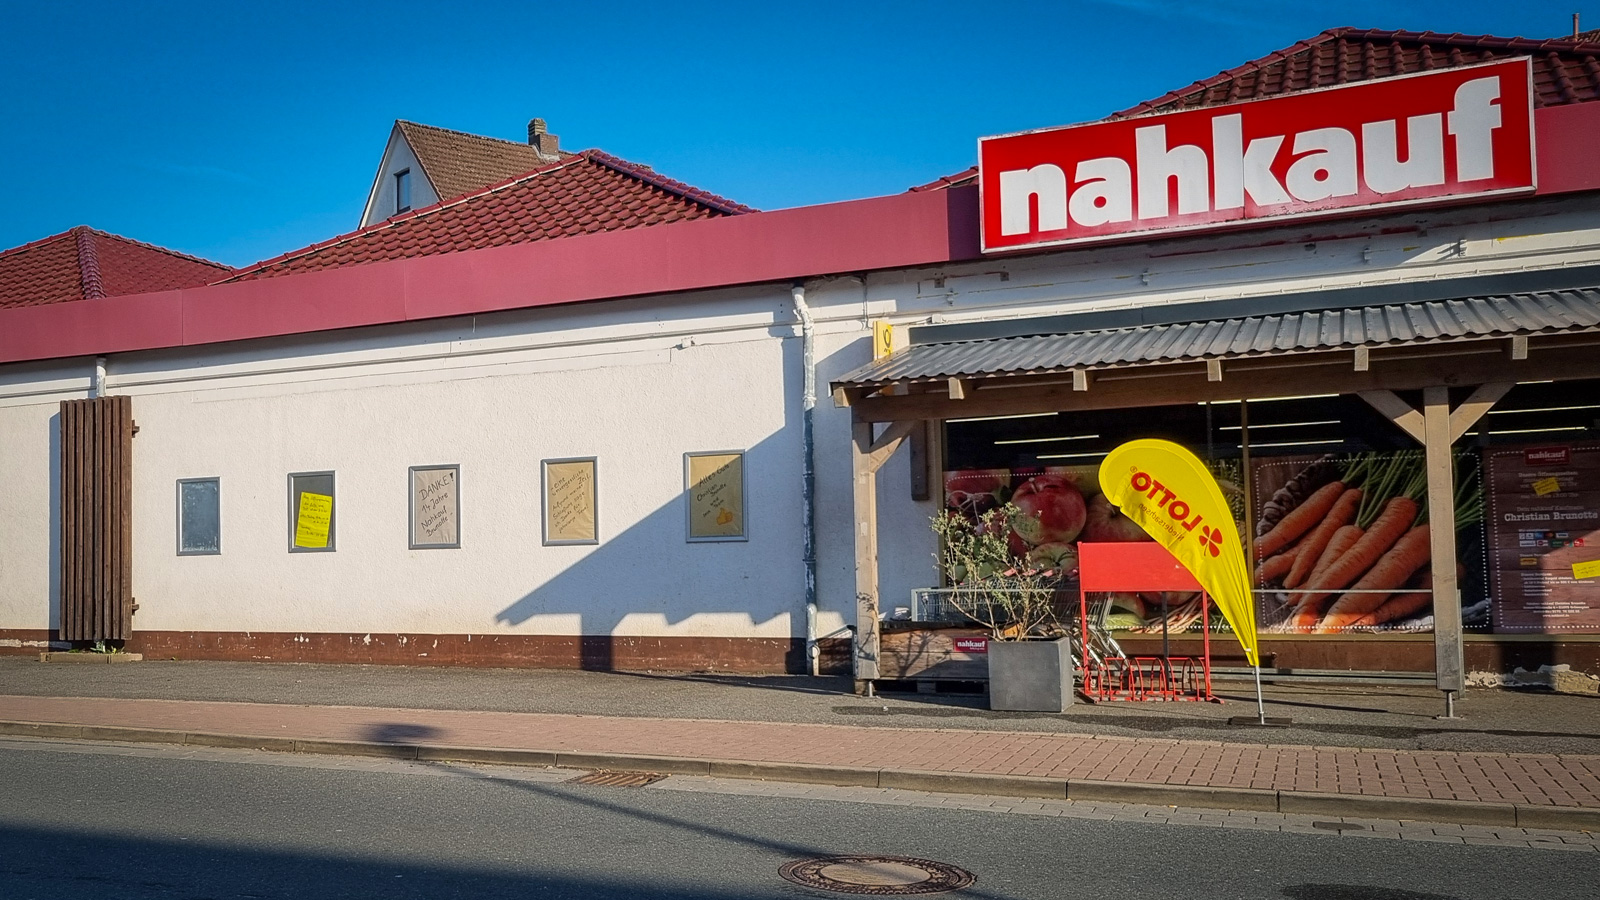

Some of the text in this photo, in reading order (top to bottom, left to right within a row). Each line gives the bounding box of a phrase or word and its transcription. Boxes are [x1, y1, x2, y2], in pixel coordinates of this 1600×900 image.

[1000, 75, 1502, 237] nahkauf
[1528, 450, 1566, 459] nahkauf
[699, 472, 716, 488] Alles
[421, 492, 449, 514] 14 Jahre
[1504, 511, 1599, 521] Christian Brunotte
[957, 640, 986, 648] nahkauf
